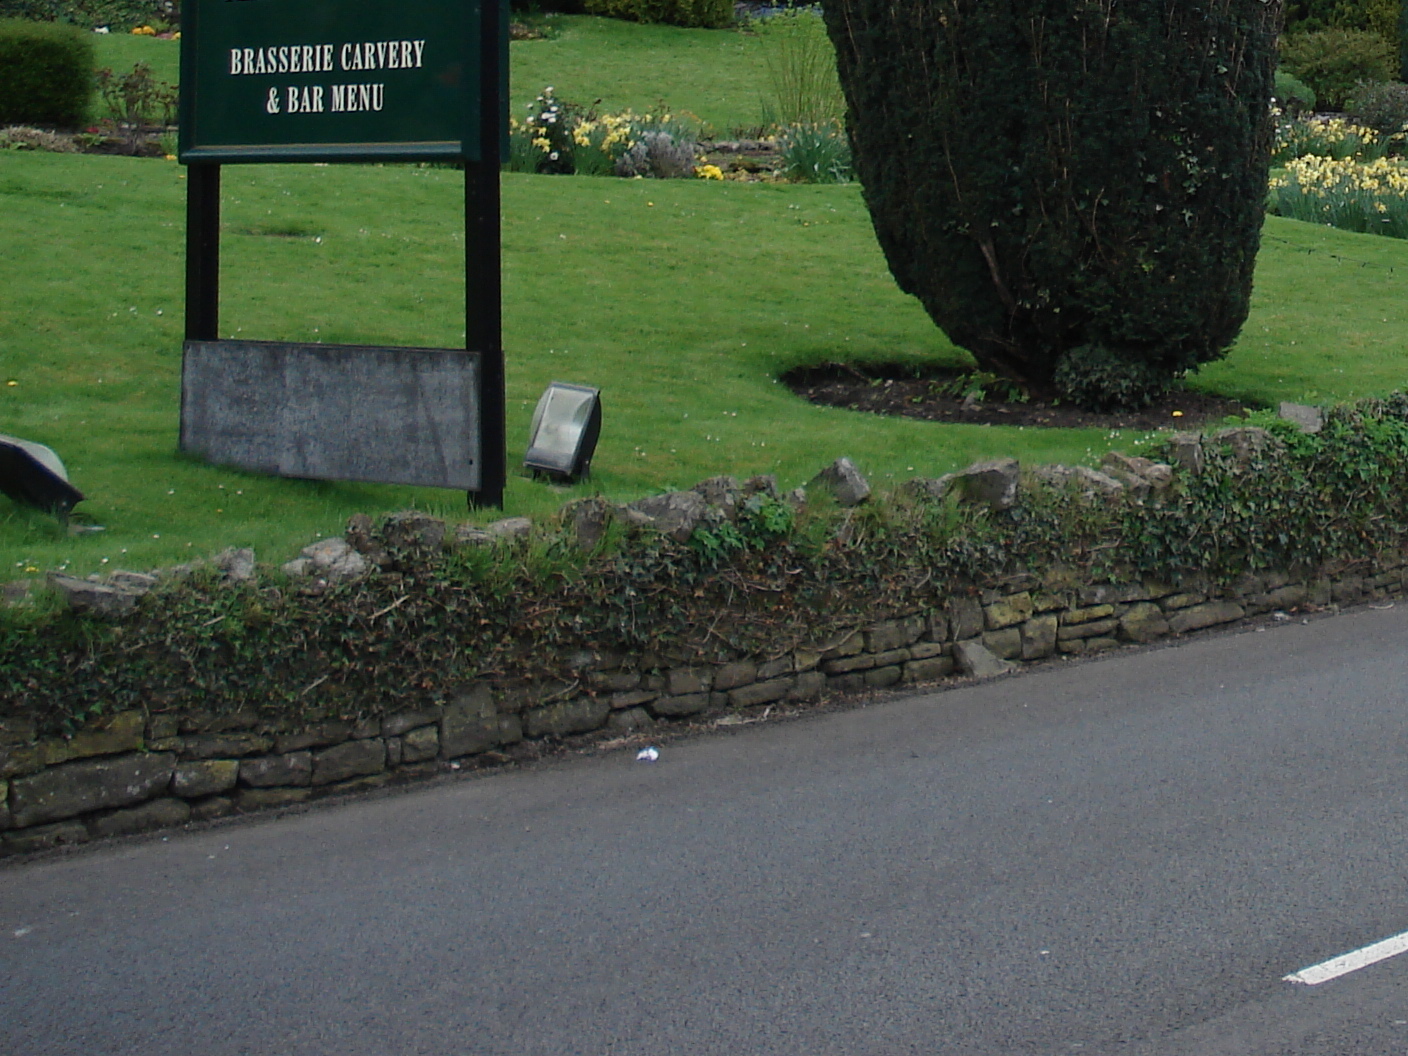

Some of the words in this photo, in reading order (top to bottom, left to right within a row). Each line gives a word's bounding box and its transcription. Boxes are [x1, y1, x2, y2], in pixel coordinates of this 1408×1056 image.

[230, 44, 333, 75] BRASSERIE
[341, 40, 425, 71] CARVERY
[267, 87, 280, 114] &
[287, 85, 324, 113] BAR
[331, 84, 384, 112] MENU
